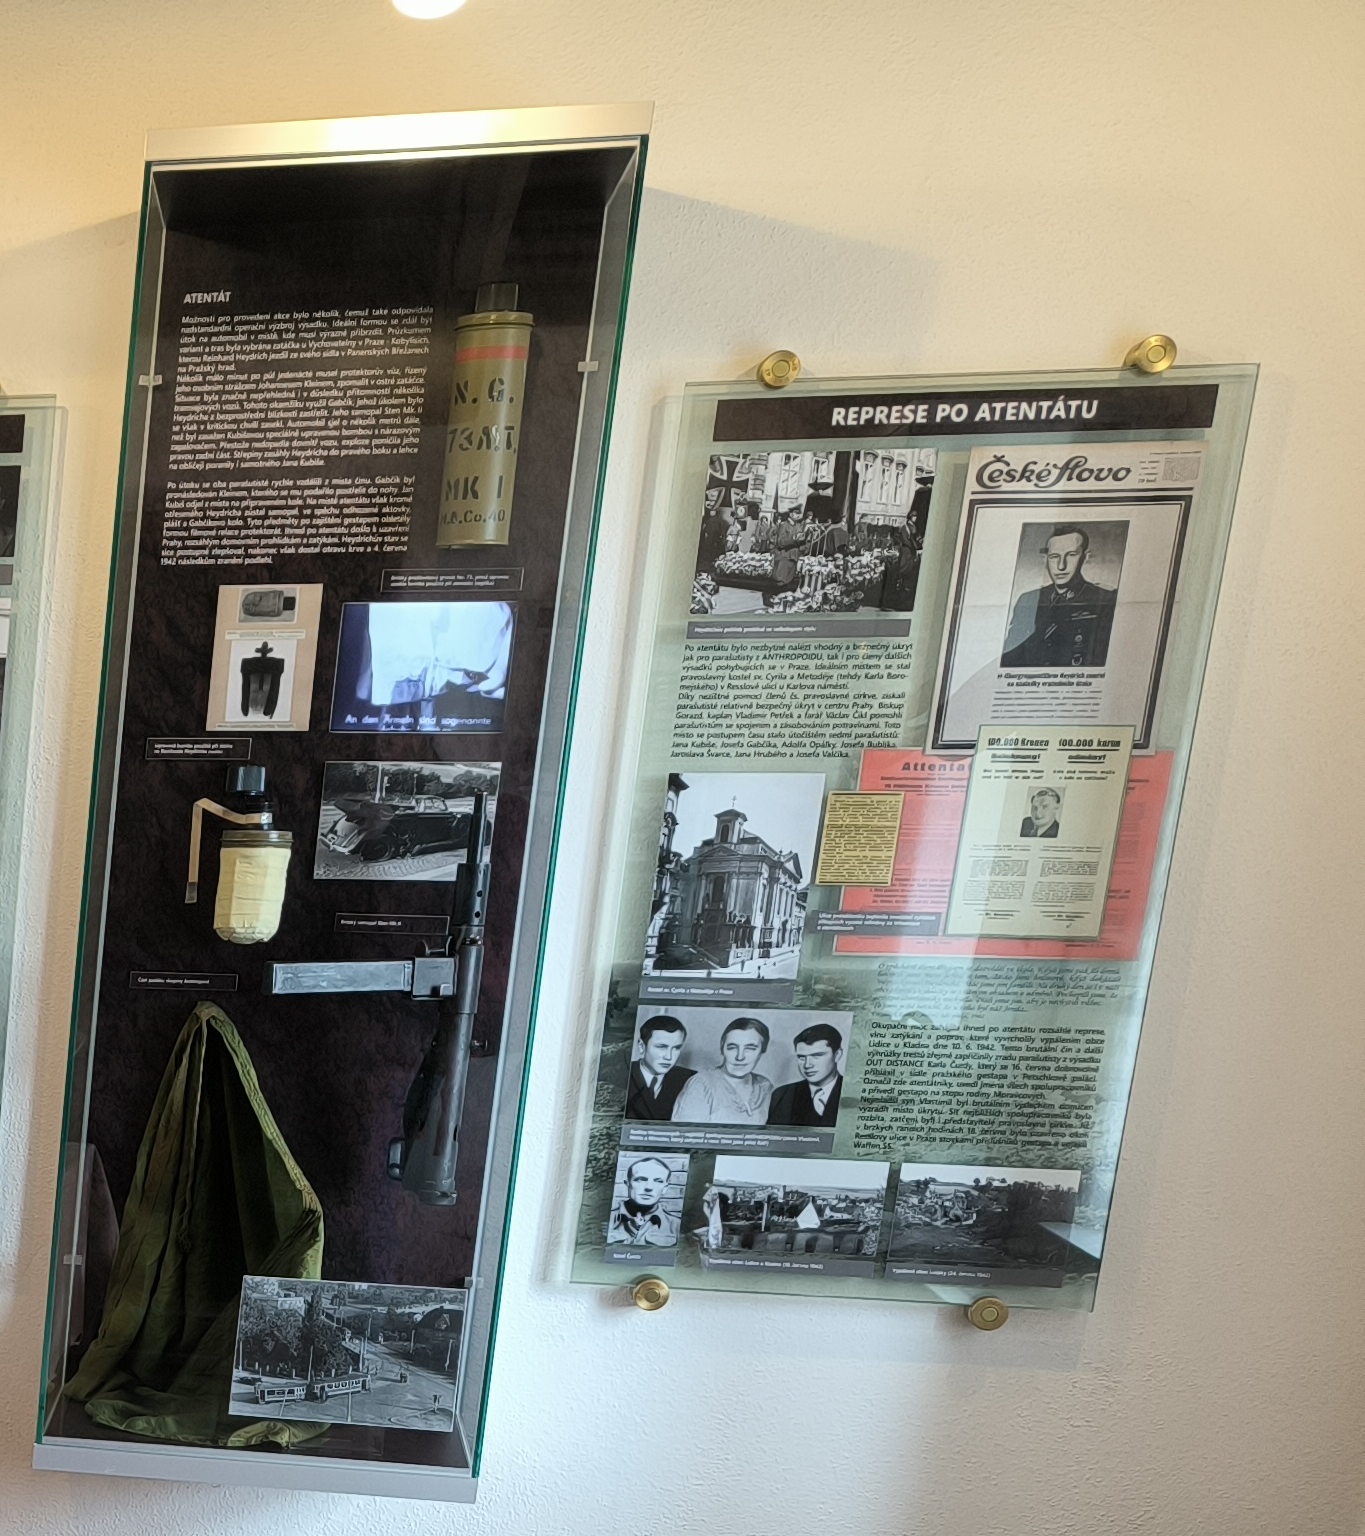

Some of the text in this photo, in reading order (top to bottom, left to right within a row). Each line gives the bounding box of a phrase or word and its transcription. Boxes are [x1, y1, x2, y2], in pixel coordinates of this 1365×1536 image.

[183, 291, 231, 304] ATENTÁT
[831, 395, 1099, 426] REPRESE PO ATENTÁTU
[901, 762, 971, 772] Attenta
